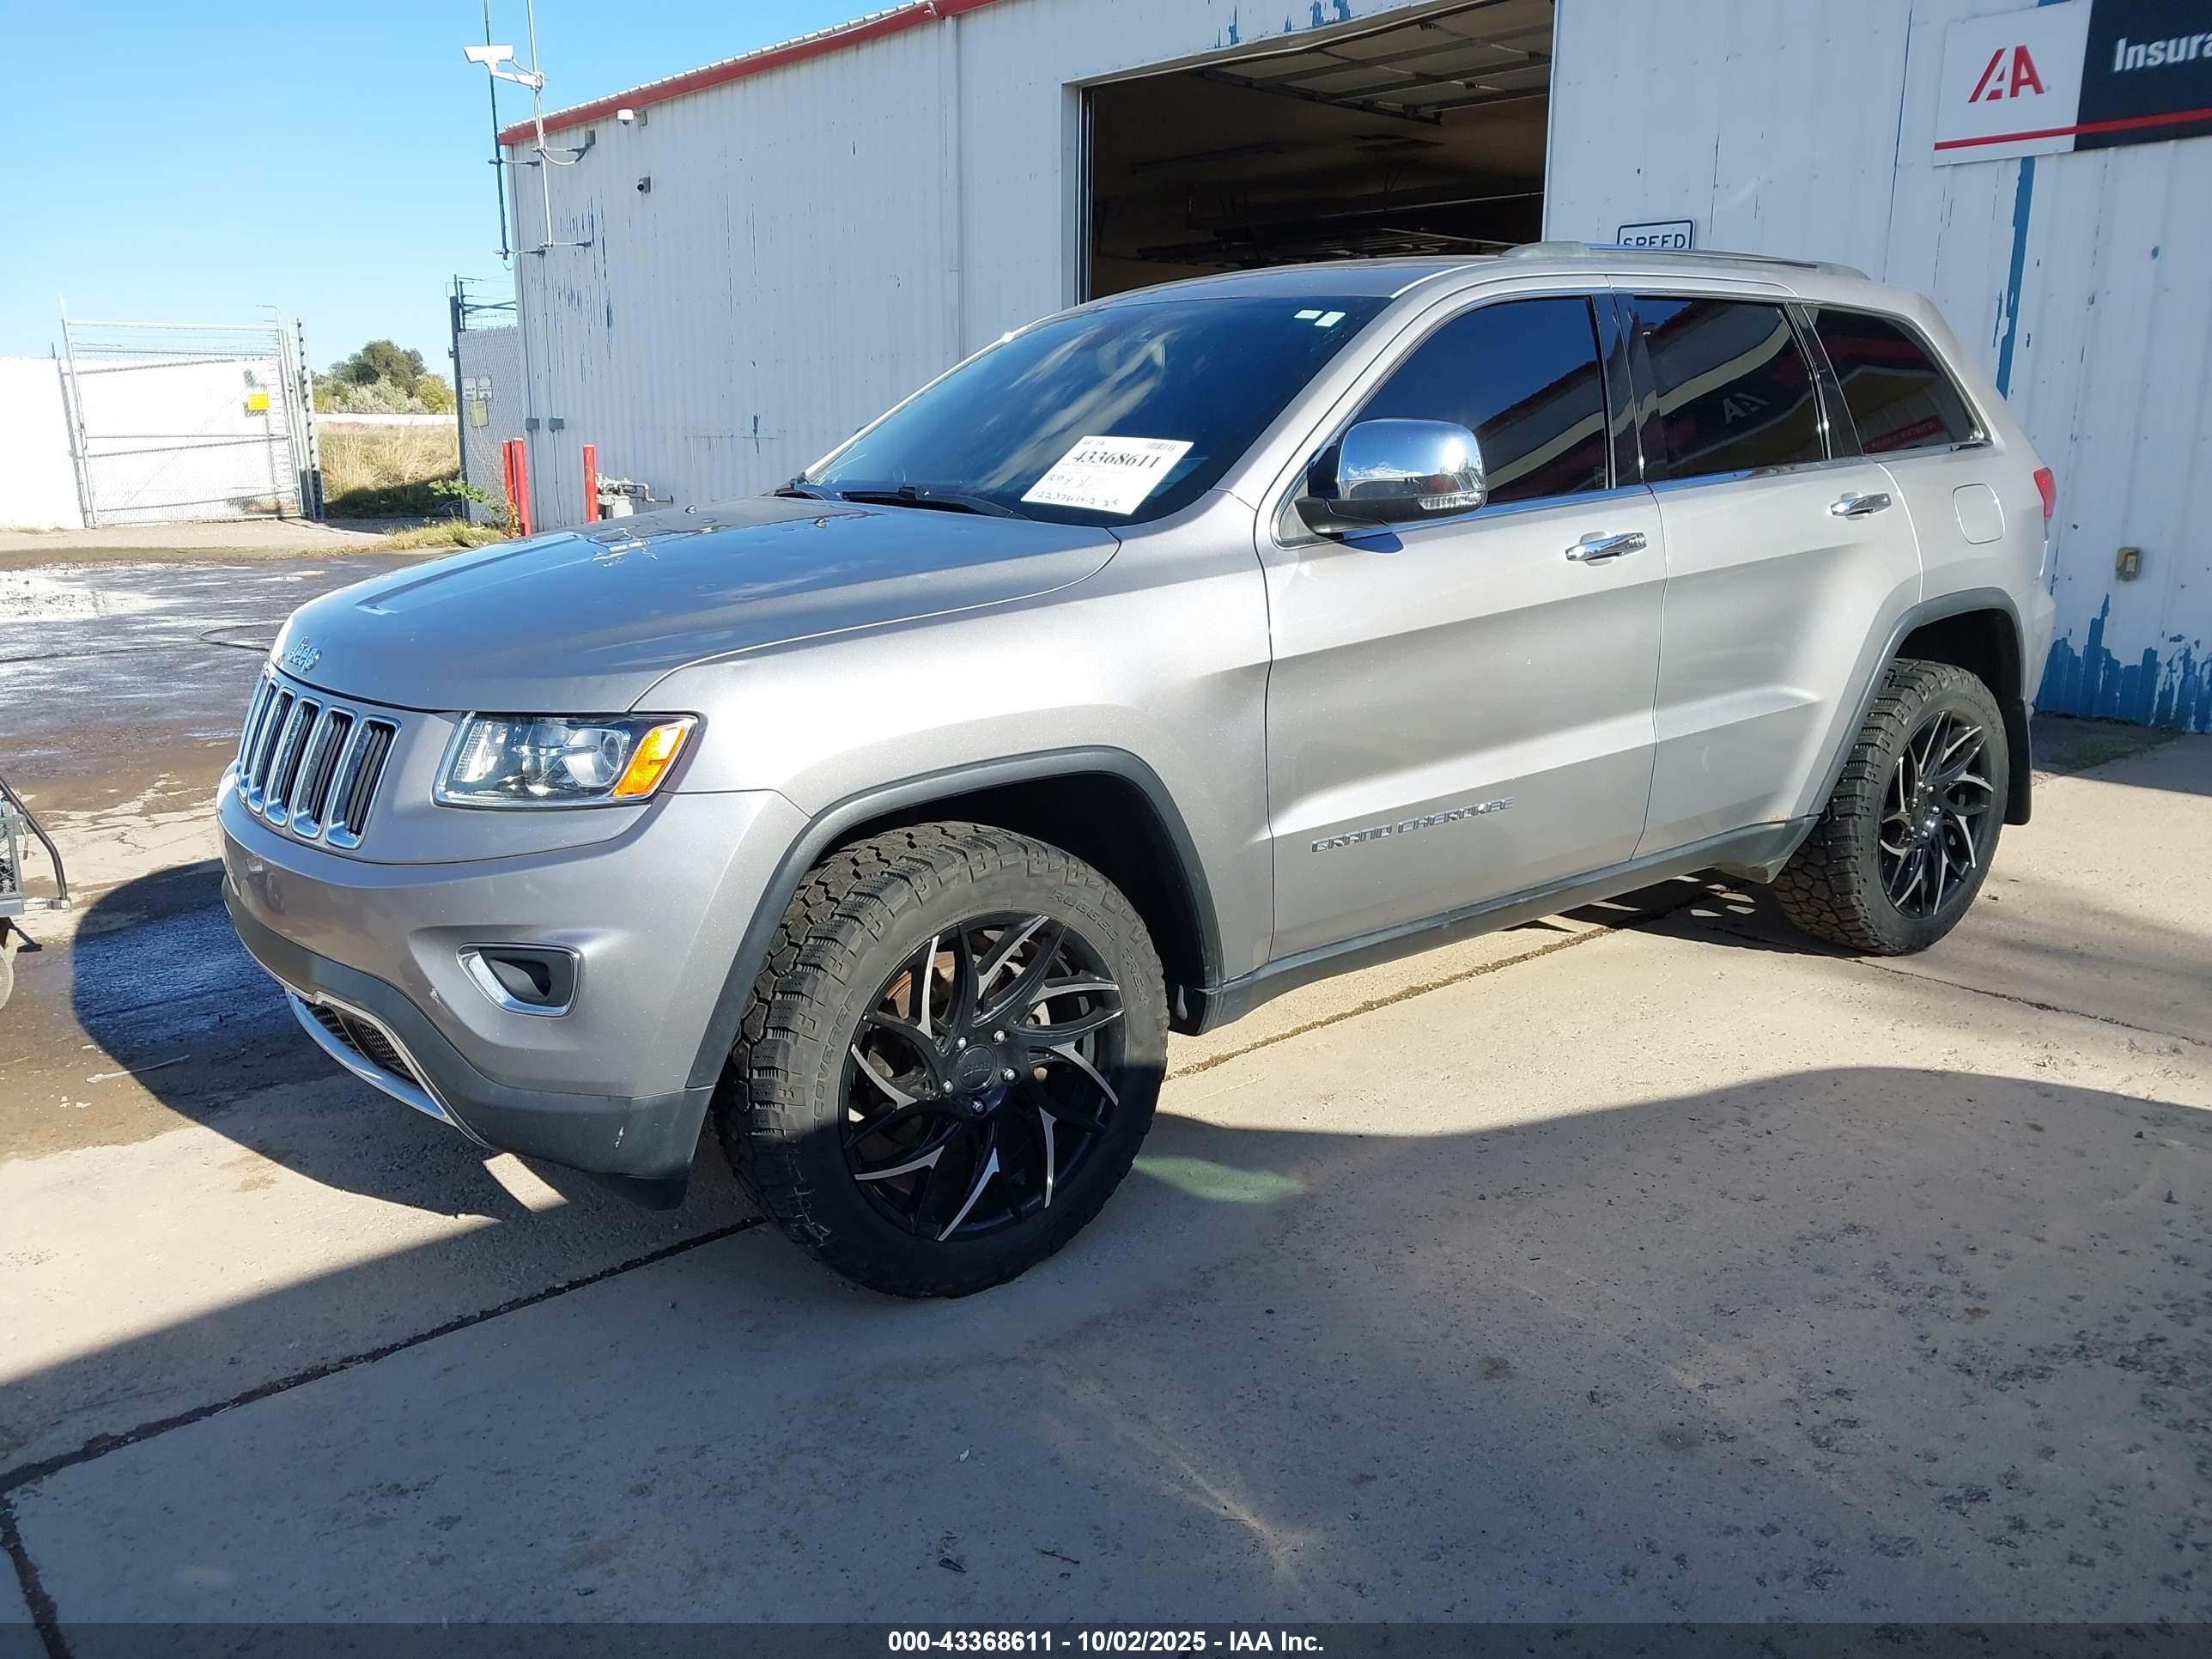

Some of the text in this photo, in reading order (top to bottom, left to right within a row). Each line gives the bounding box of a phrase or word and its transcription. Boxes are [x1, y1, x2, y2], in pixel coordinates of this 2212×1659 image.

[1073, 450, 1162, 468] 43368611
[1311, 797, 1515, 853] GRAND CHEROKEE
